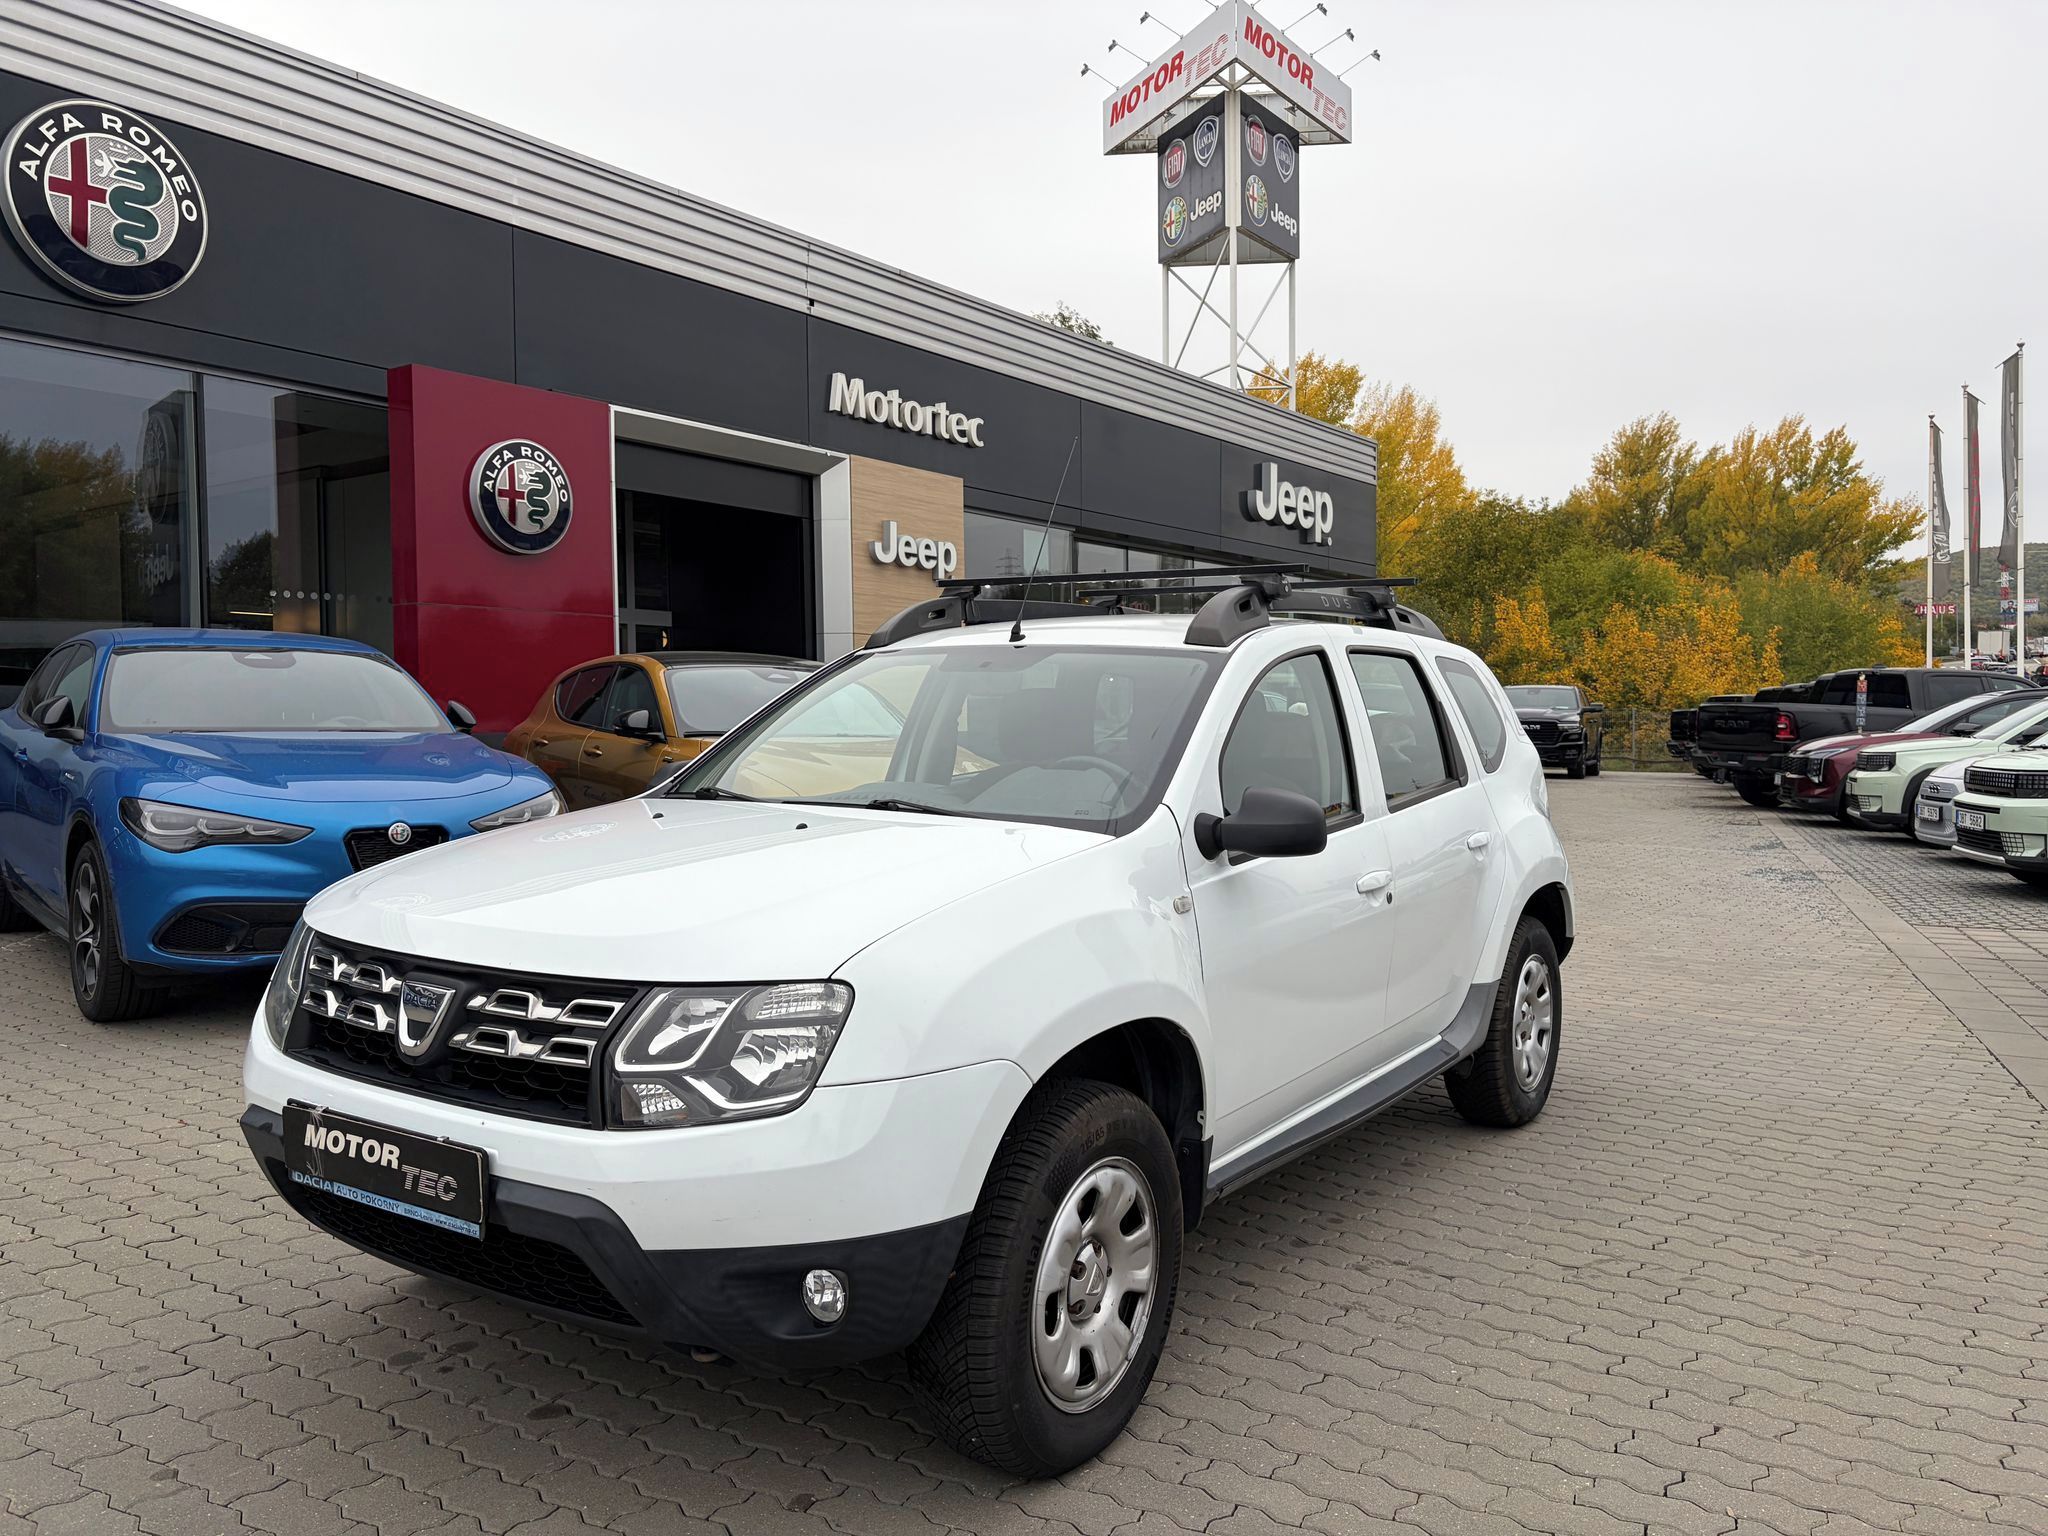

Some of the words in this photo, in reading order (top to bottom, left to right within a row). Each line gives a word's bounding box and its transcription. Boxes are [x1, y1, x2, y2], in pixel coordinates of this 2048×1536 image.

[1110, 50, 1185, 128] MOTOR
[1183, 33, 1229, 88] TEC
[1244, 15, 1313, 90] MOTOR
[1312, 86, 1347, 130] TEC
[19, 112, 85, 182] ALFA
[101, 112, 198, 222] ROMEO
[1167, 150, 1181, 178] FIAT
[1190, 190, 1222, 222] Jeep
[1270, 203, 1297, 236] Jeep
[829, 371, 985, 448] Motortec
[483, 449, 514, 493] ALFA
[520, 446, 568, 503] ROMEO
[1247, 461, 1334, 545] Jeep
[869, 519, 957, 580] Jeep
[404, 992, 438, 1009] DACIA
[294, 1170, 333, 1193] DACIA
[336, 1185, 359, 1200] AUTO
[304, 1124, 401, 1170] MOTOR
[401, 1164, 458, 1201] TEC
